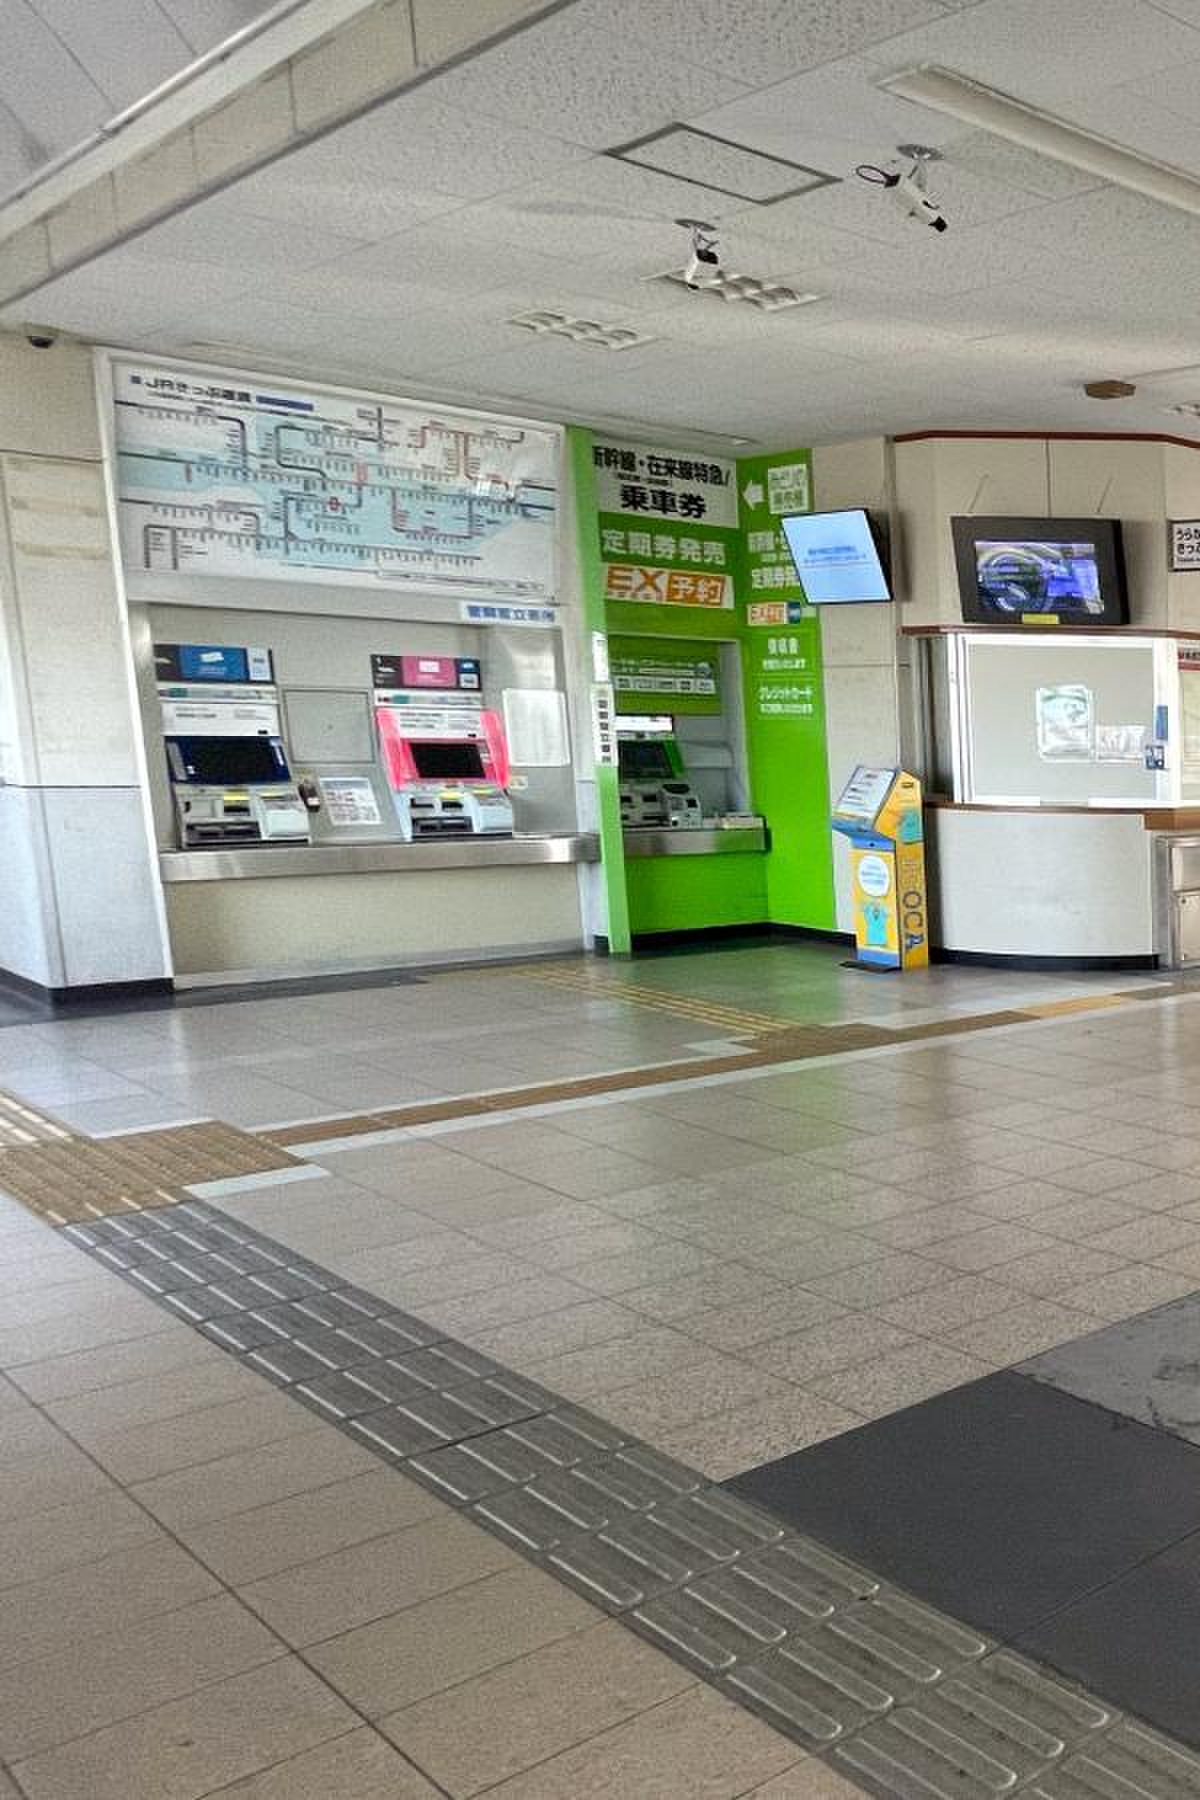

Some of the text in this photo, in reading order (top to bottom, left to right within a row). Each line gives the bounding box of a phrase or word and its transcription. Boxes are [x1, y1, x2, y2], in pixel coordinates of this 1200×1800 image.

[620, 484, 707, 518] 乗車券
[602, 530, 726, 565] 定期券発売
